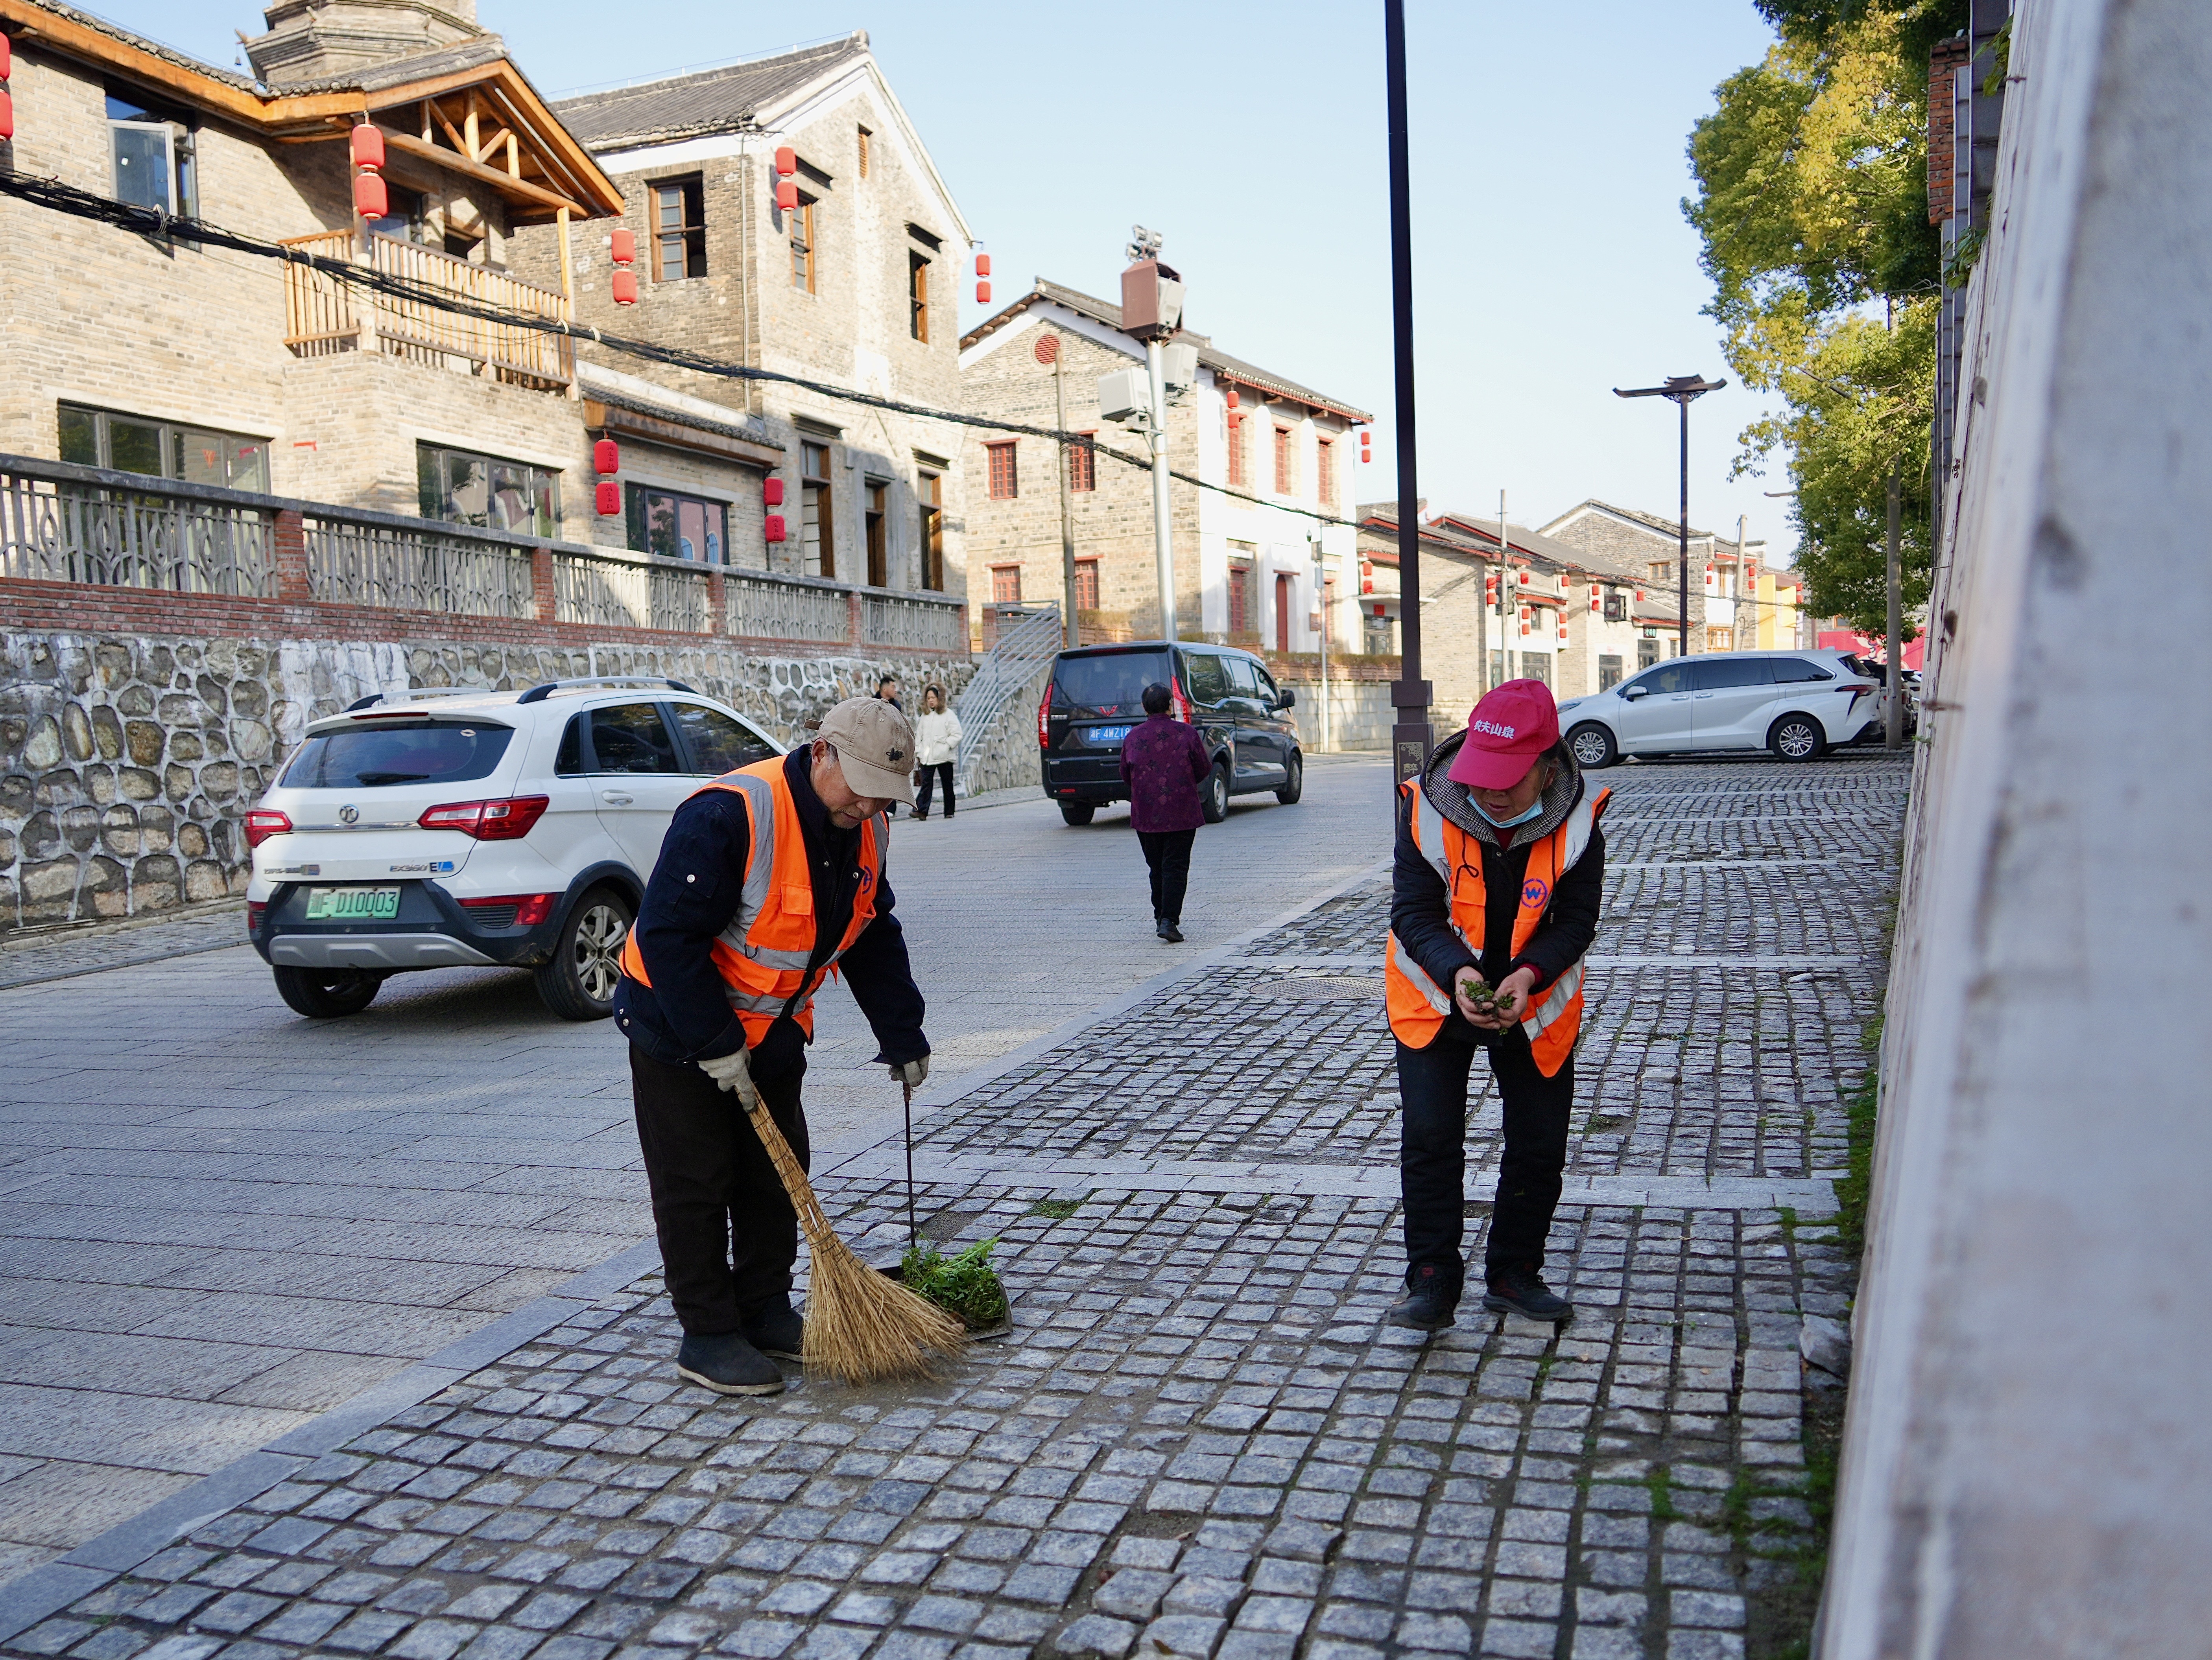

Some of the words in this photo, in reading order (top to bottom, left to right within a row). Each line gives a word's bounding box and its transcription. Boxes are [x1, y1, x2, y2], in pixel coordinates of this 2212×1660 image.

[1474, 719, 1515, 739] 农夫山泉
[1403, 763, 1418, 774] 醉
